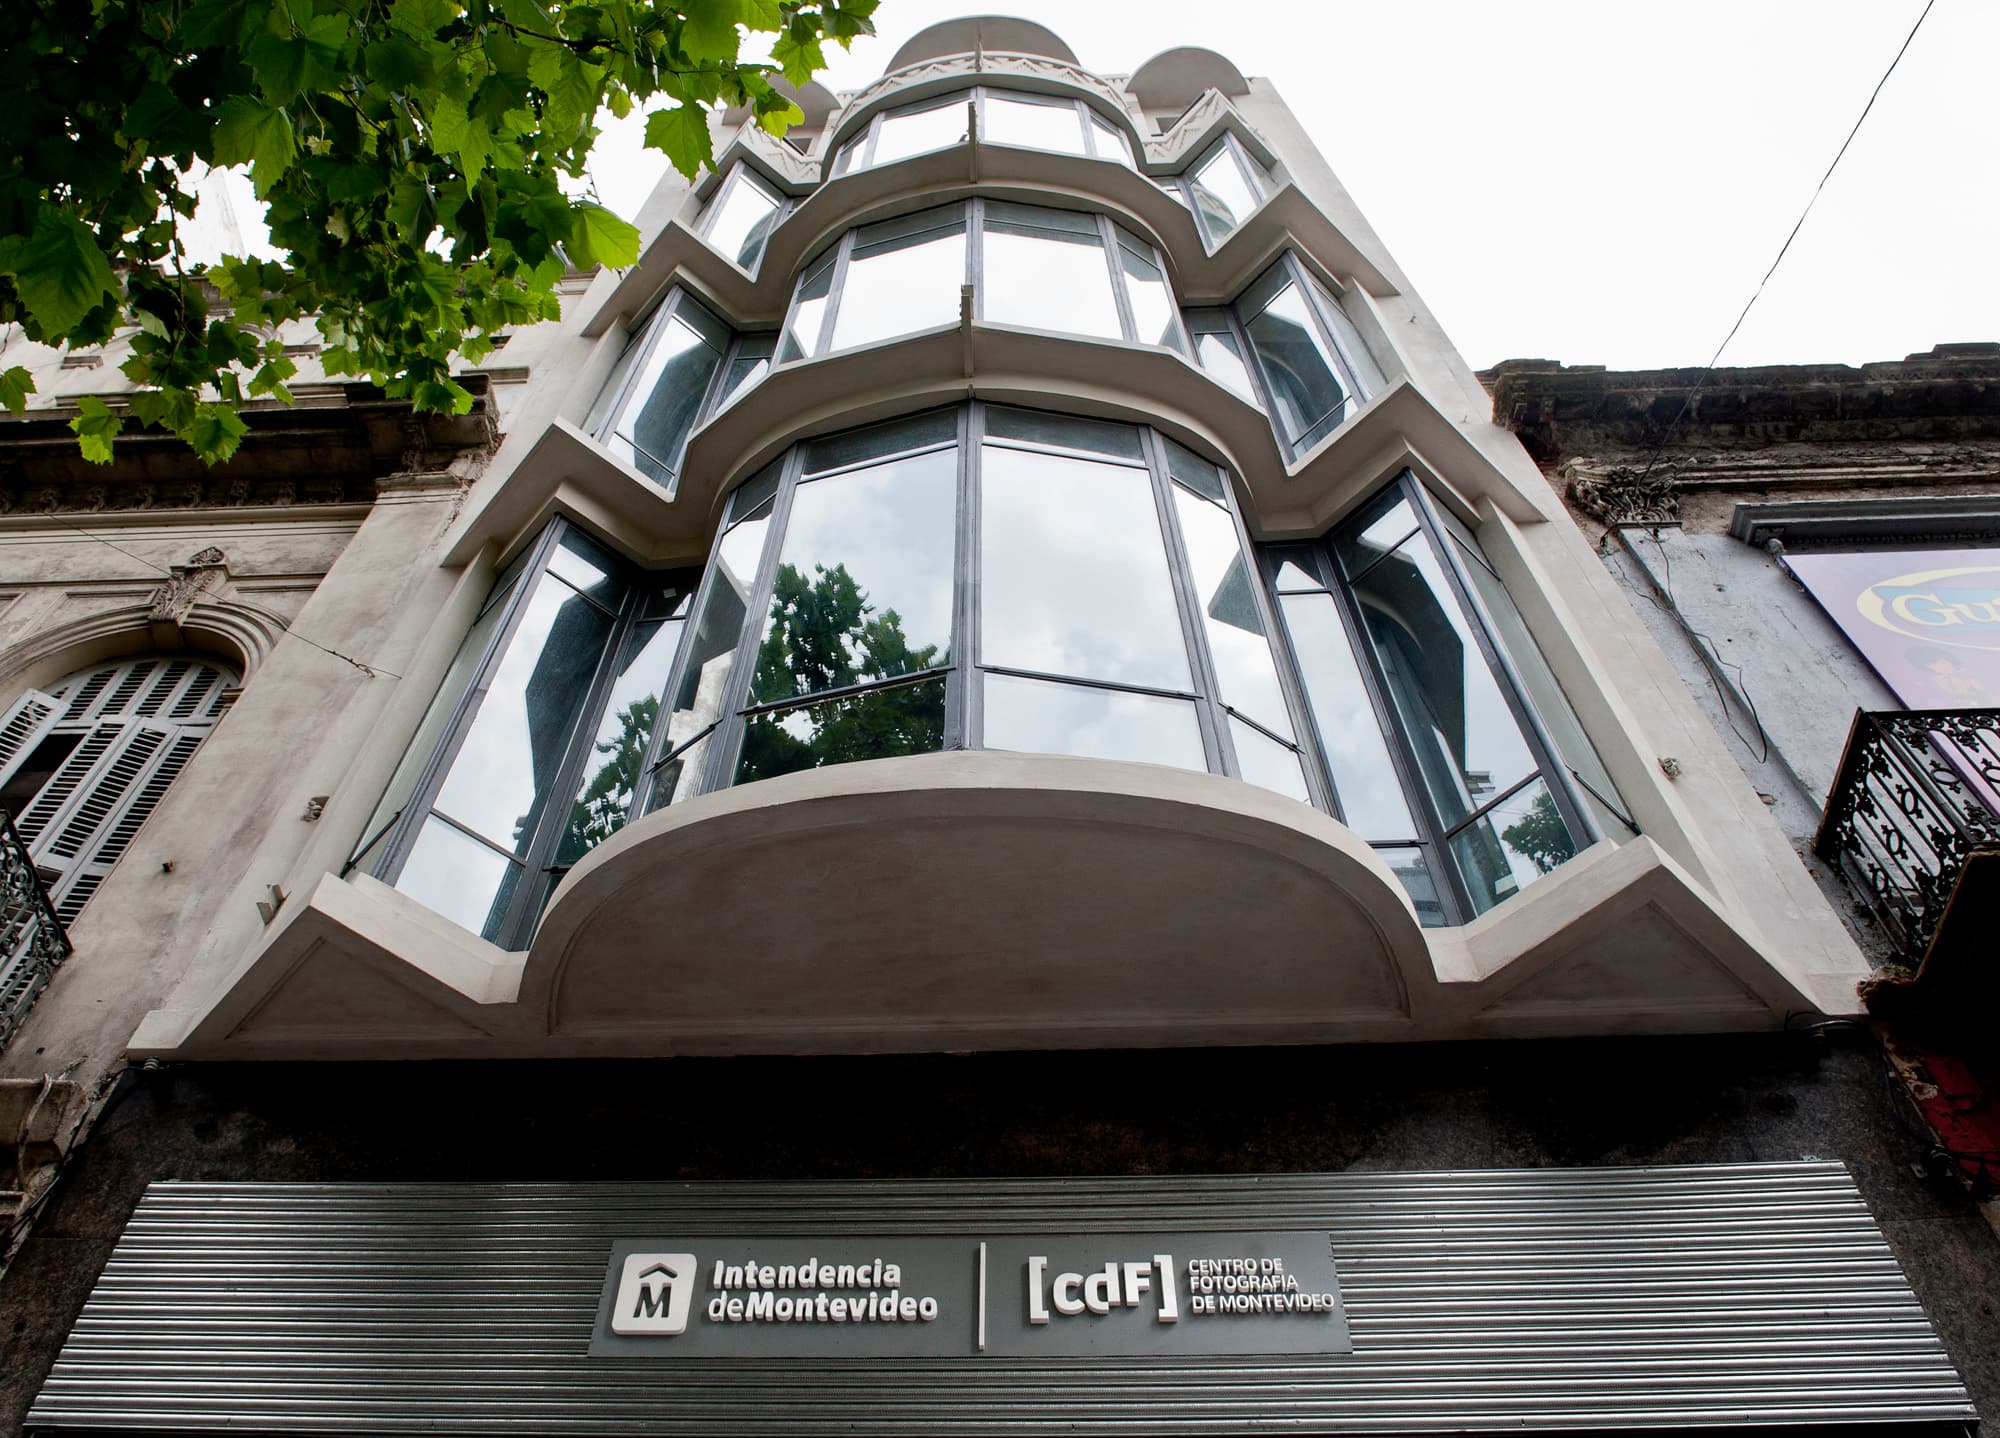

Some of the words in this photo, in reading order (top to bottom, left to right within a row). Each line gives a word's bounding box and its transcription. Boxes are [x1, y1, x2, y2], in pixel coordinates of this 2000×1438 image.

[1891, 593, 2000, 625] Gu
[712, 1258, 901, 1289] Intendencia
[1188, 1259, 1258, 1276] CENTRO
[1260, 1258, 1284, 1275] DE
[1192, 1295, 1216, 1314] DE
[1219, 1293, 1335, 1313] MONTEVIDEO
